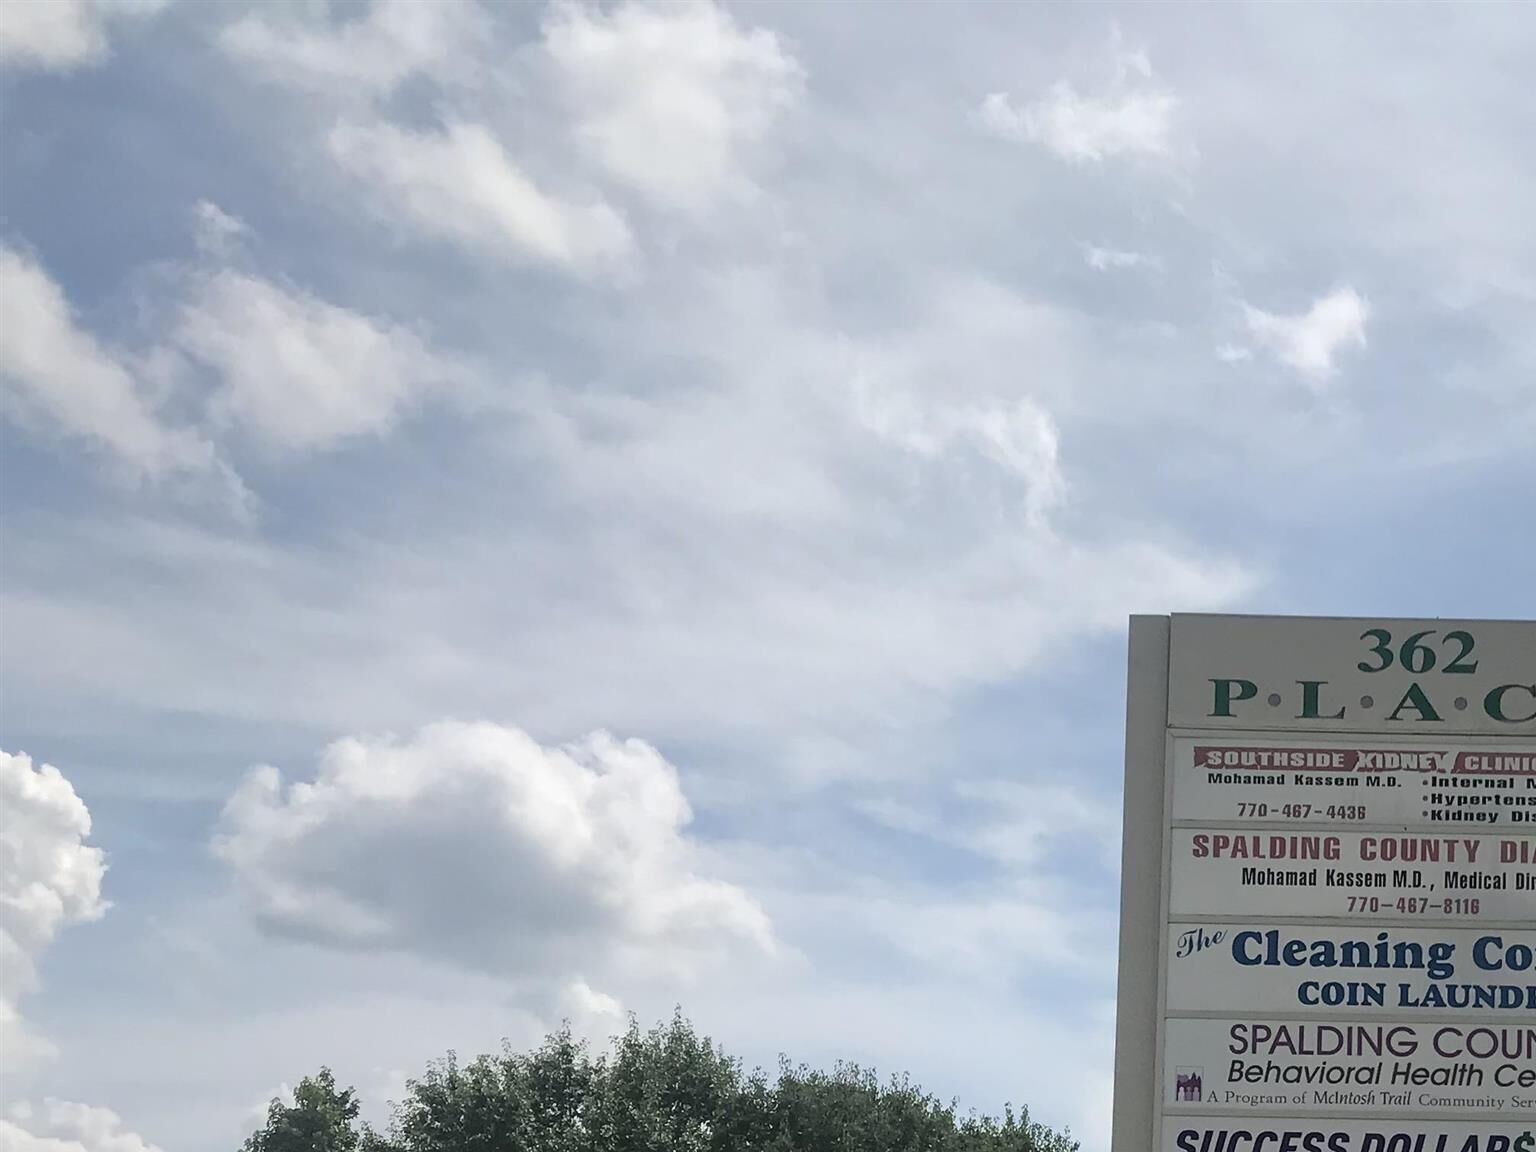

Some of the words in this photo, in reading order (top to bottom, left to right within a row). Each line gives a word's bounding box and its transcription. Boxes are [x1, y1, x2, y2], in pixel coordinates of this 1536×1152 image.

[1357, 629, 1479, 674] 362
[1207, 751, 1345, 768] SOUTHSIDE
[1358, 752, 1447, 770] KIDNEY
[1207, 773, 1285, 785] Mohamad
[1294, 774, 1359, 787] Kassem
[1366, 775, 1402, 788] M.D.
[1431, 776, 1514, 789] Internal
[1430, 809, 1499, 823] Kidney
[1192, 834, 1341, 860] SPALDING
[1359, 837, 1480, 863] COUNTY
[1241, 867, 1317, 886] Mohamad
[1326, 868, 1387, 888] Kassem
[1392, 870, 1435, 891] M.D.,
[1444, 871, 1507, 890] Medical
[1347, 896, 1480, 915] 770-467-8116
[1176, 928, 1228, 958] The
[1231, 930, 1456, 980] Cleaning
[1297, 981, 1387, 1007] COIN
[1228, 1023, 1419, 1057] SPALDING
[1228, 1060, 1383, 1085] Behavioral
[1390, 1062, 1484, 1087] Health
[1207, 1090, 1219, 1103] A
[1224, 1091, 1287, 1106] Program
[1292, 1091, 1307, 1104] of
[1313, 1090, 1376, 1105] McIntosh
[1379, 1091, 1411, 1106] Trail
[1418, 1093, 1505, 1110] Community
